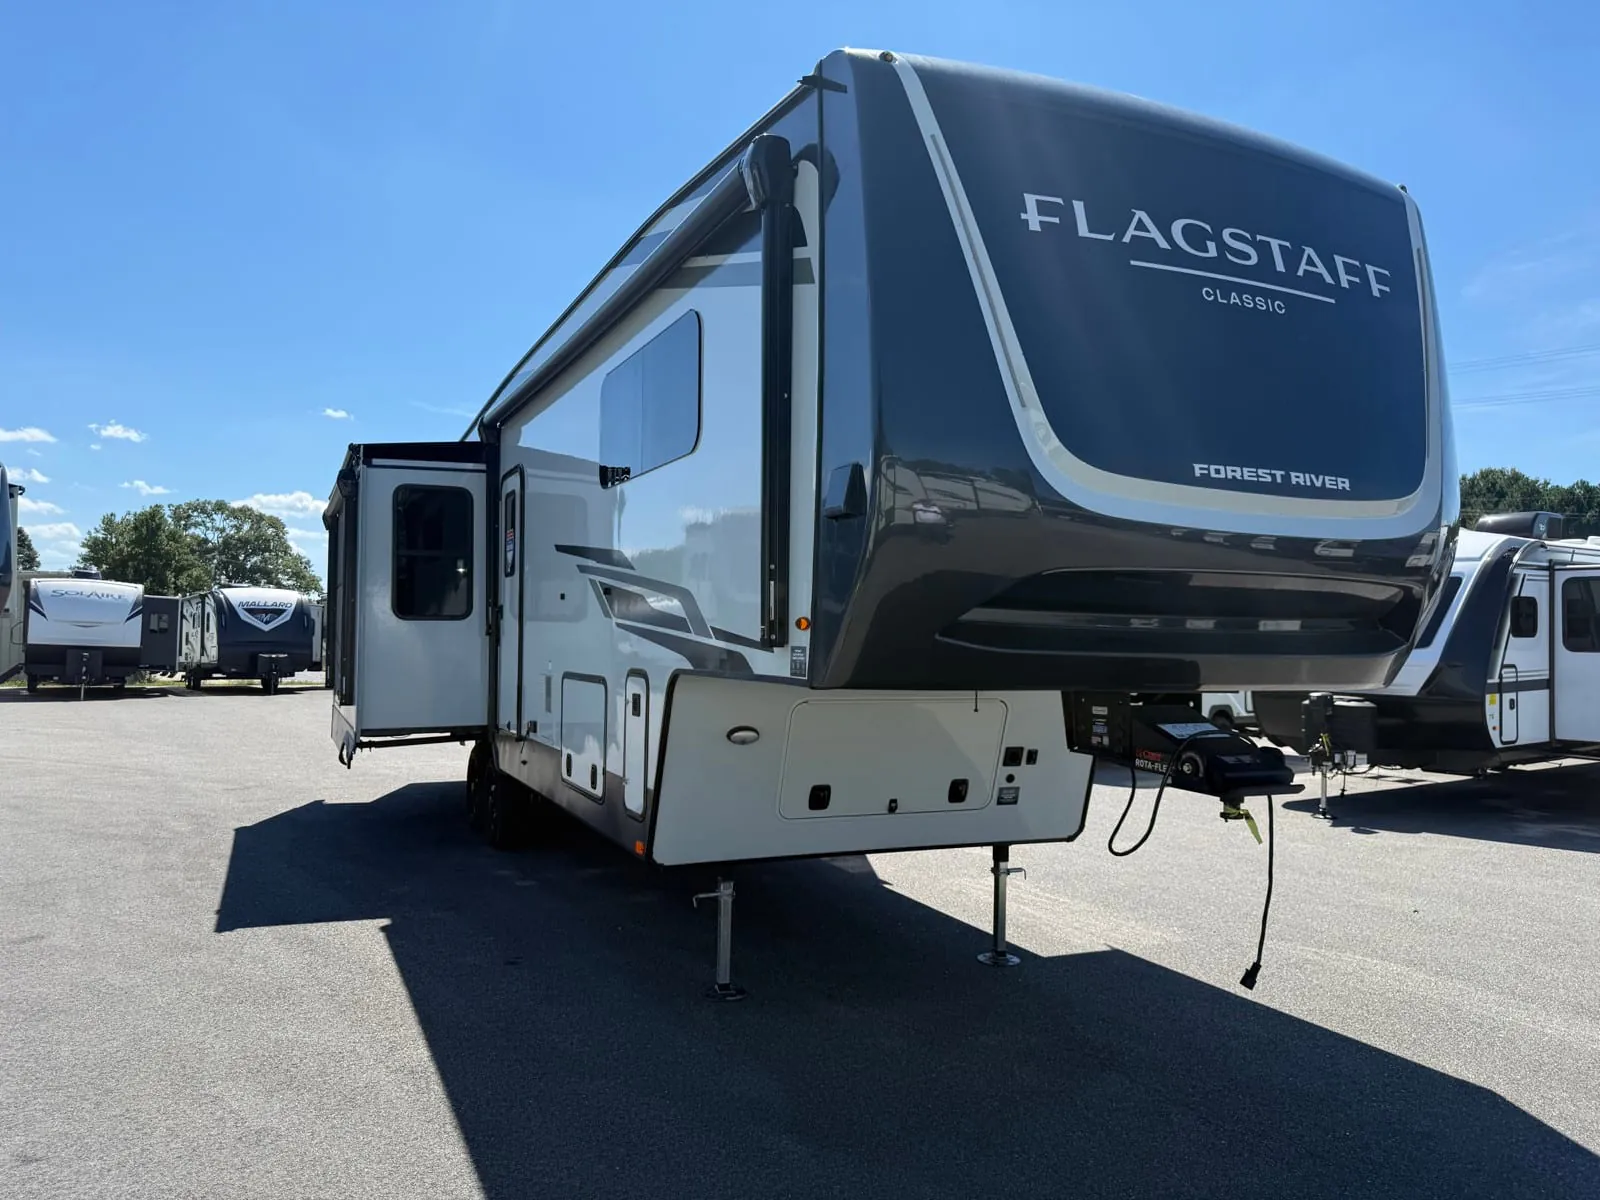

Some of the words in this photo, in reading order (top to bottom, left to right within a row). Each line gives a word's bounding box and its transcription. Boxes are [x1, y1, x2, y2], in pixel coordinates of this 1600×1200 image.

[1020, 193, 1392, 298] FLAGSTAFF
[1202, 287, 1286, 315] CLASSIC
[1192, 463, 1286, 484] FOREST
[1289, 471, 1351, 491] RIVER
[1135, 758, 1169, 773] ROTA-FLE
